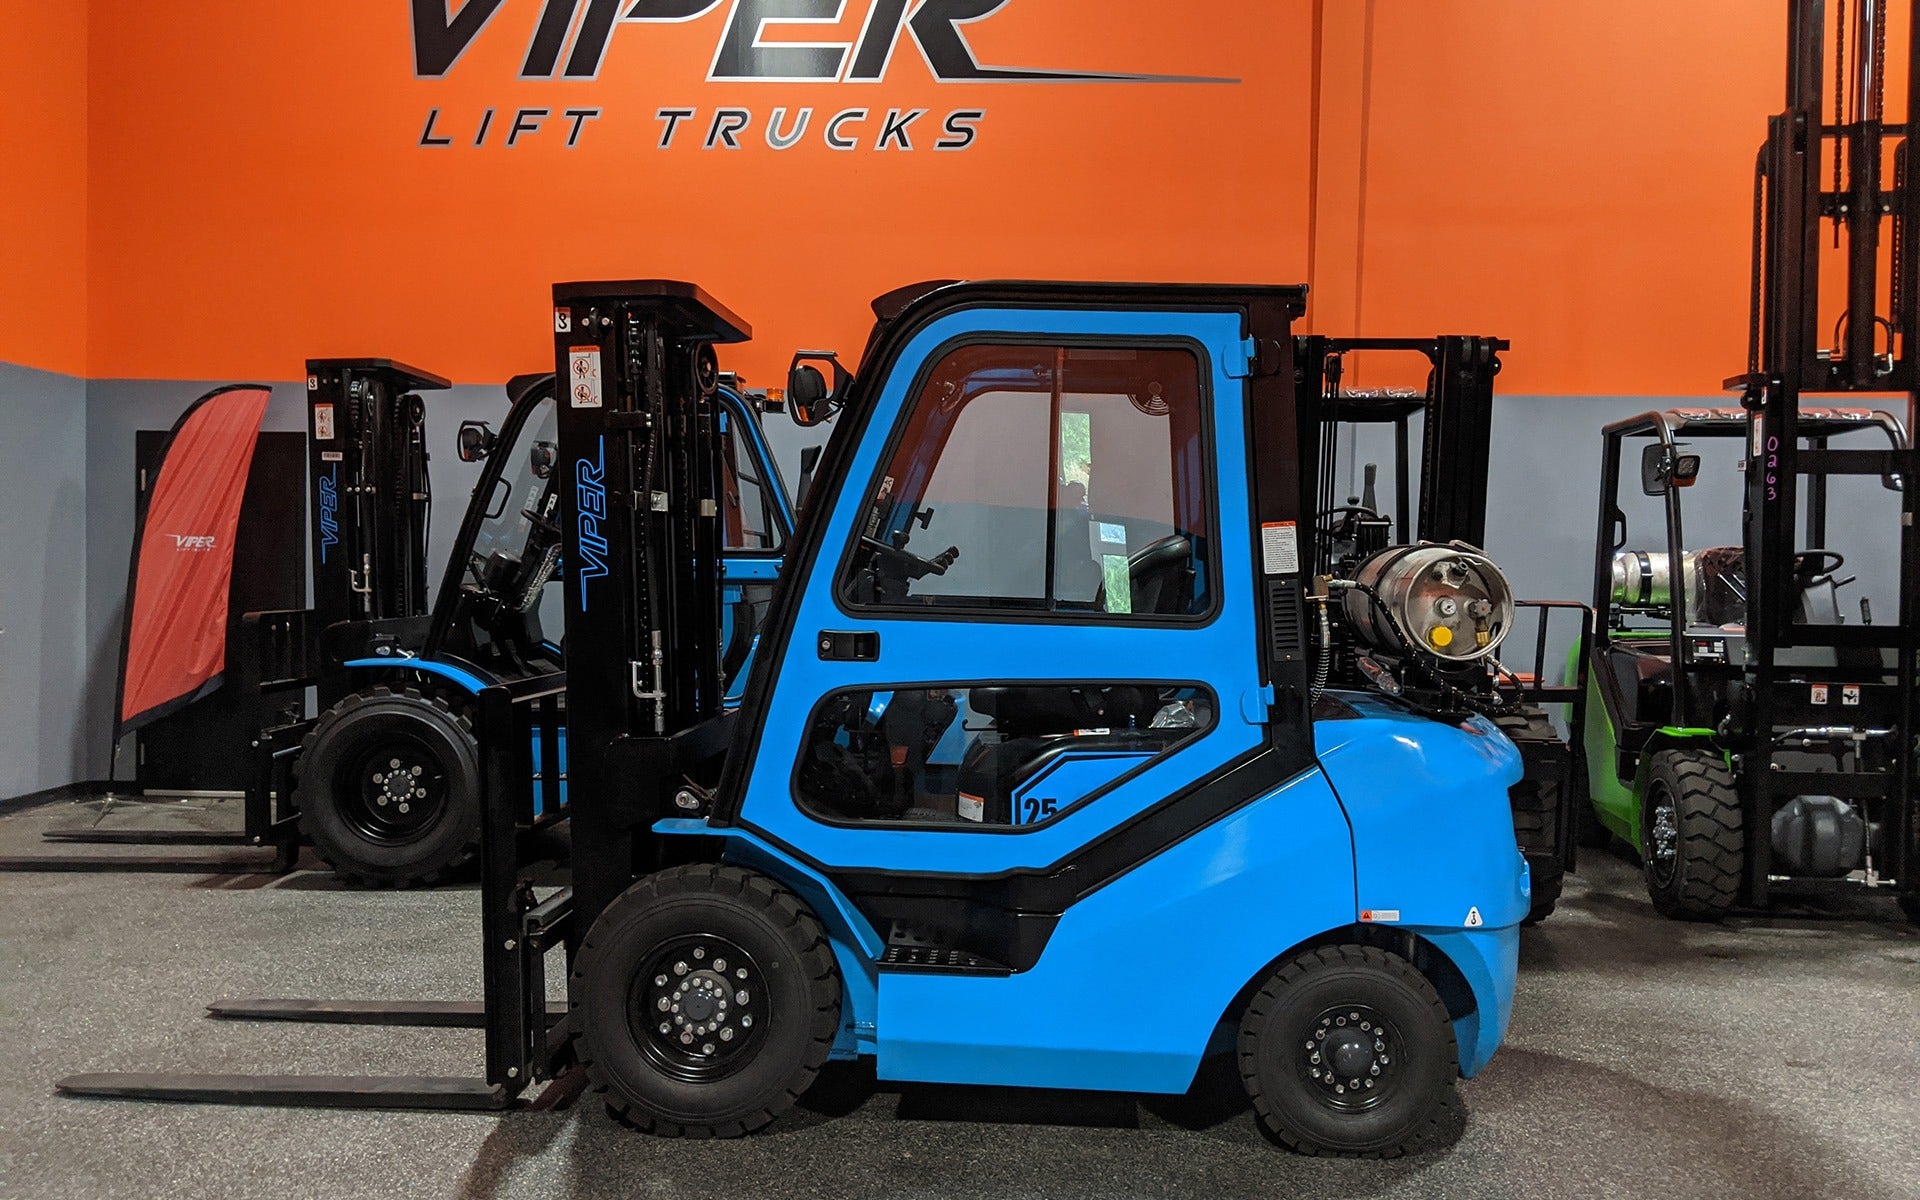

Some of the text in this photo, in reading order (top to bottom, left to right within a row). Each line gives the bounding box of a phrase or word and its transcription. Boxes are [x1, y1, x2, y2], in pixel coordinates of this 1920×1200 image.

[417, 106, 986, 152] LIFT TRUCKS
[165, 534, 217, 548] VIPER
[319, 462, 339, 565] VIPER
[576, 434, 609, 612] VIPER
